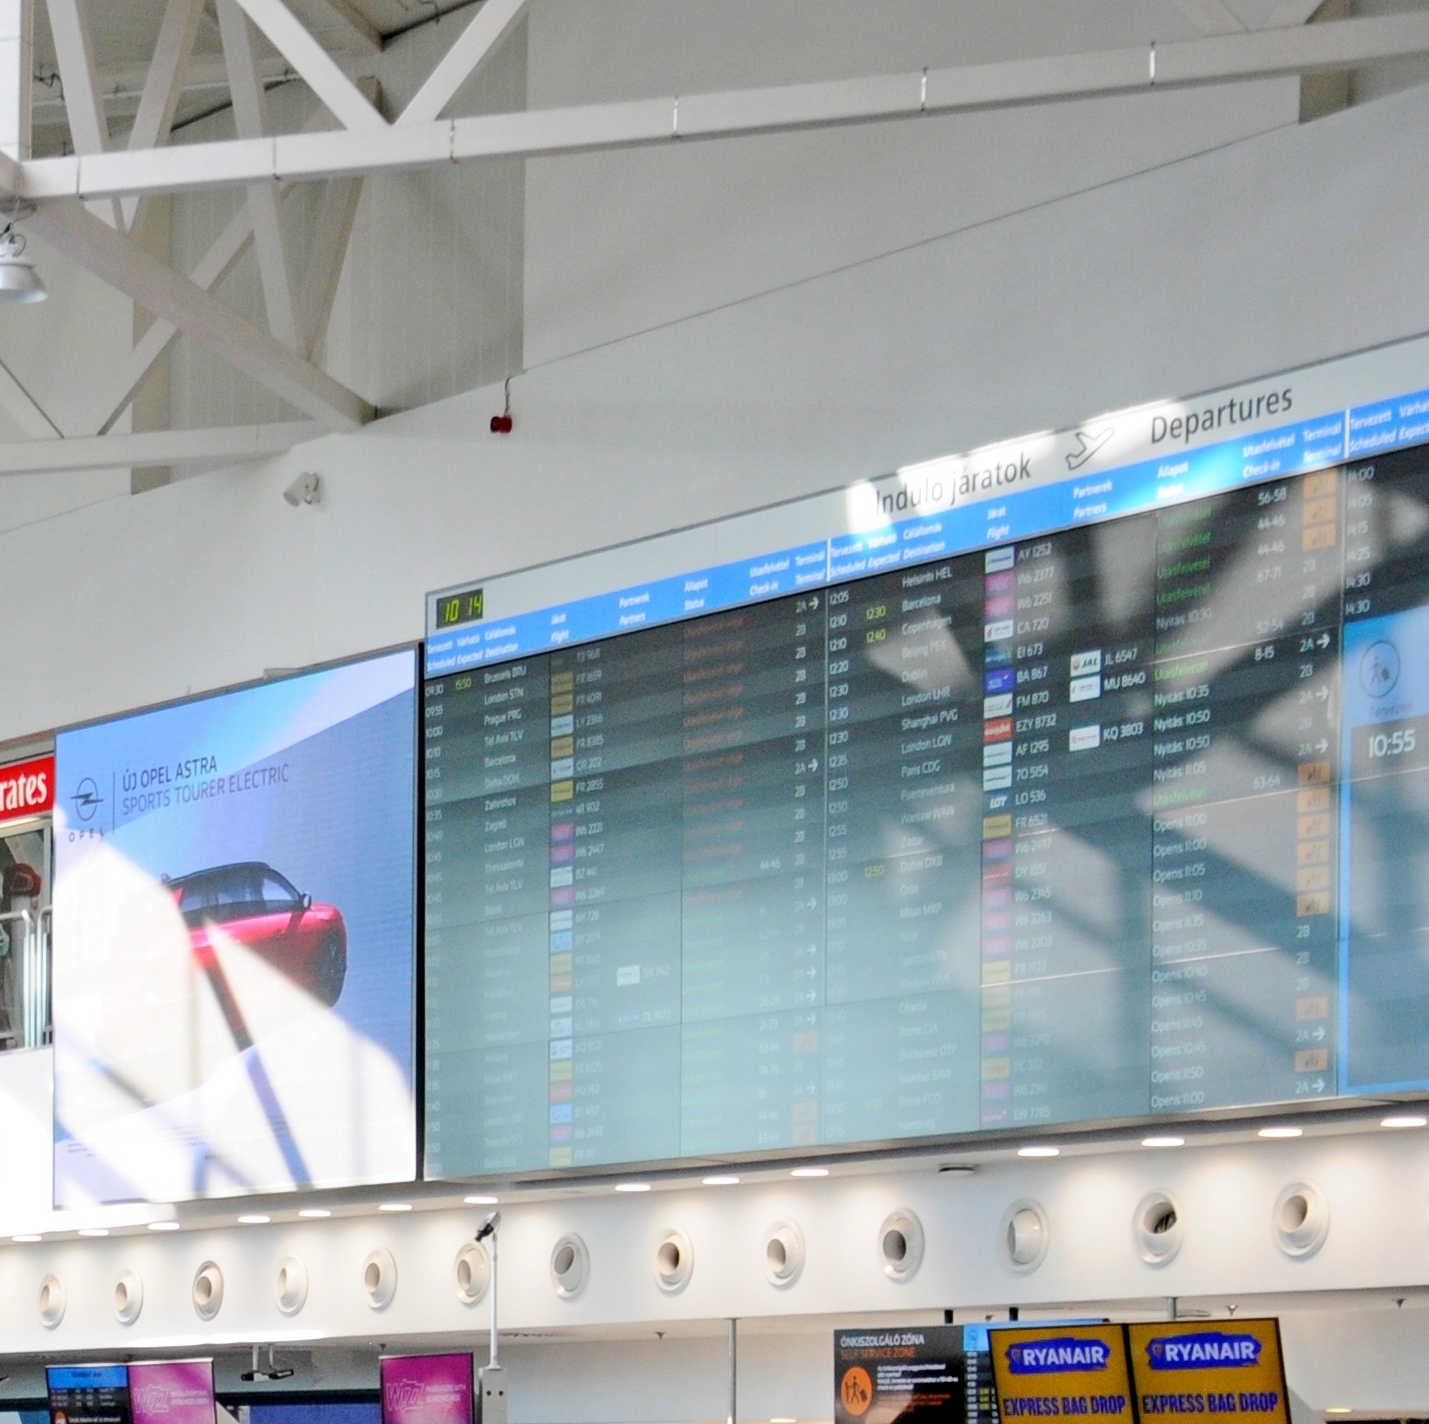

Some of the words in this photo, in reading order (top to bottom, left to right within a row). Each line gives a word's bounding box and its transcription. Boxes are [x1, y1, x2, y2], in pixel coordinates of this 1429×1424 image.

[1151, 388, 1293, 444] Departures
[950, 452, 1032, 505] járatok
[1073, 480, 1113, 498] Partnerek
[1257, 487, 1288, 506] 56-58
[1073, 502, 1107, 519] Partners
[1345, 573, 1371, 588] 14:30
[444, 600, 460, 622] 10
[468, 595, 483, 616] 14
[1345, 599, 1371, 615] 14:30
[1104, 676, 1120, 691] MU
[1122, 672, 1145, 687] 8640
[1154, 692, 1184, 708] Nyitás
[1185, 685, 1209, 699] 10:35
[902, 712, 938, 730] Shanghai
[940, 709, 958, 722] PVG
[1153, 715, 1184, 732] Nyitás
[1186, 709, 1211, 724] 10:50
[1104, 726, 1118, 740] KQ
[1121, 723, 1144, 738] 3803
[1153, 740, 1184, 757] Nyitás
[1186, 735, 1211, 750] 10:50
[1369, 729, 1417, 758] 10:55
[122, 768, 137, 792] ÚJ
[141, 765, 172, 787] OPEL
[175, 755, 218, 779] ASTRA
[122, 790, 171, 816] SPORTS
[174, 778, 224, 804] TOURER
[229, 763, 289, 793] ELECTRIC
[901, 1333, 925, 1345] ZÓNA
[1023, 1347, 1104, 1366] RYANAIR
[1165, 1342, 1255, 1363] RYANAIR
[1004, 1396, 1060, 1416] EXPRESS
[1063, 1396, 1088, 1415] BAG
[1091, 1395, 1127, 1414] DROP
[1143, 1393, 1204, 1414] EXPRESS
[1208, 1393, 1237, 1413] BAG
[1240, 1392, 1279, 1412] DROP
